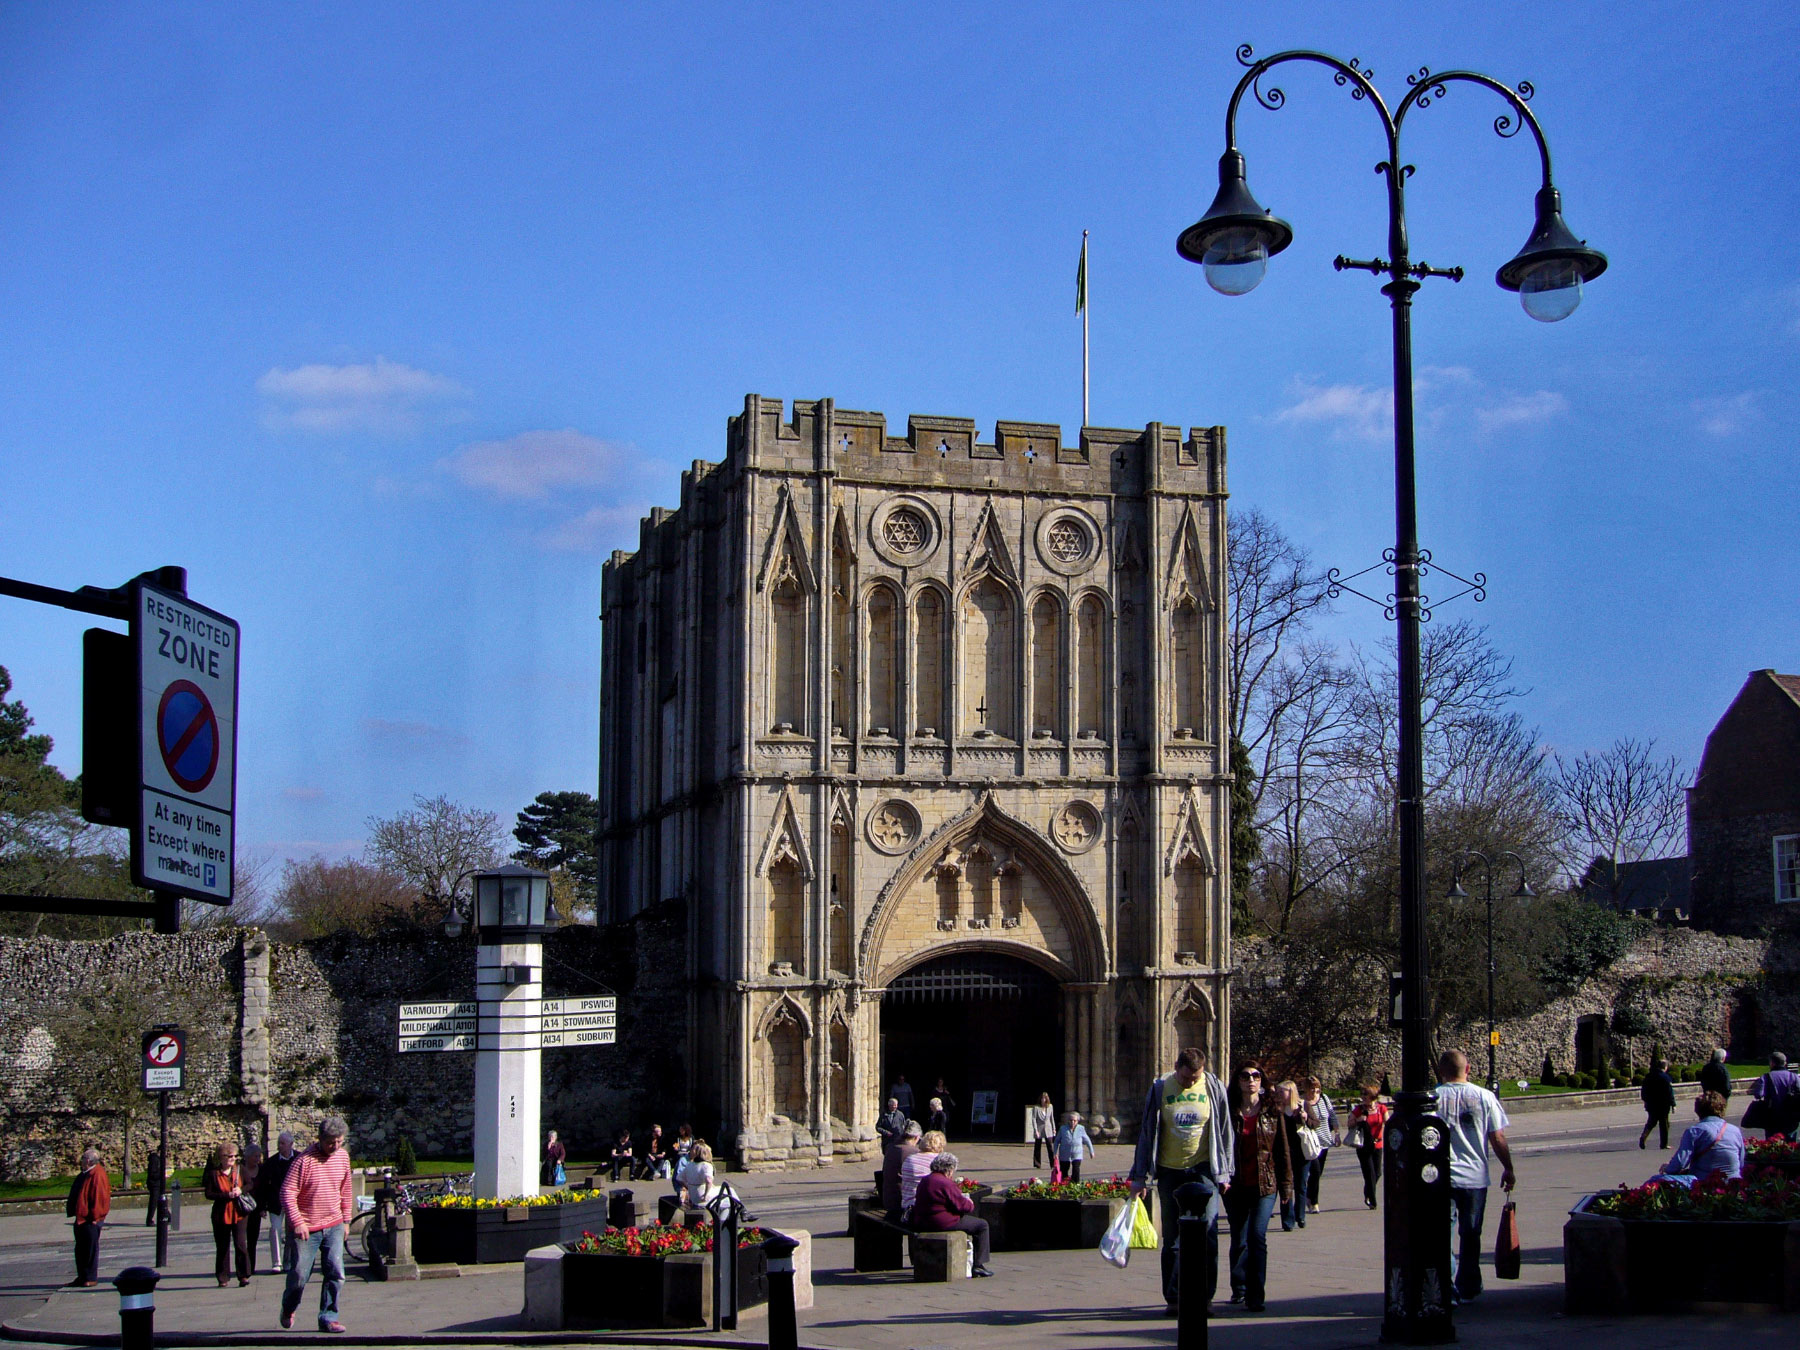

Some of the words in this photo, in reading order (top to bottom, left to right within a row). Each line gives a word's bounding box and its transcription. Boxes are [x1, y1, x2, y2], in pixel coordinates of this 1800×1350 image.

[147, 597, 230, 648] RESTRICTED
[158, 627, 220, 679] ZONE
[155, 801, 169, 821] At
[172, 811, 193, 831] any
[196, 815, 221, 837] time
[148, 825, 188, 853] Except
[192, 841, 226, 863] where
[402, 1005, 448, 1015] YARMOUTH
[457, 1004, 476, 1014] A143
[581, 999, 615, 1010] IPSWICH
[401, 1021, 452, 1032] MILDENHALL
[455, 1020, 475, 1030] A1101
[564, 1015, 616, 1027] STOWMARKET
[402, 1039, 444, 1049] THETFORD
[456, 1038, 475, 1047] A134
[543, 1034, 561, 1044] A134
[576, 1031, 613, 1042] SUDBURY
